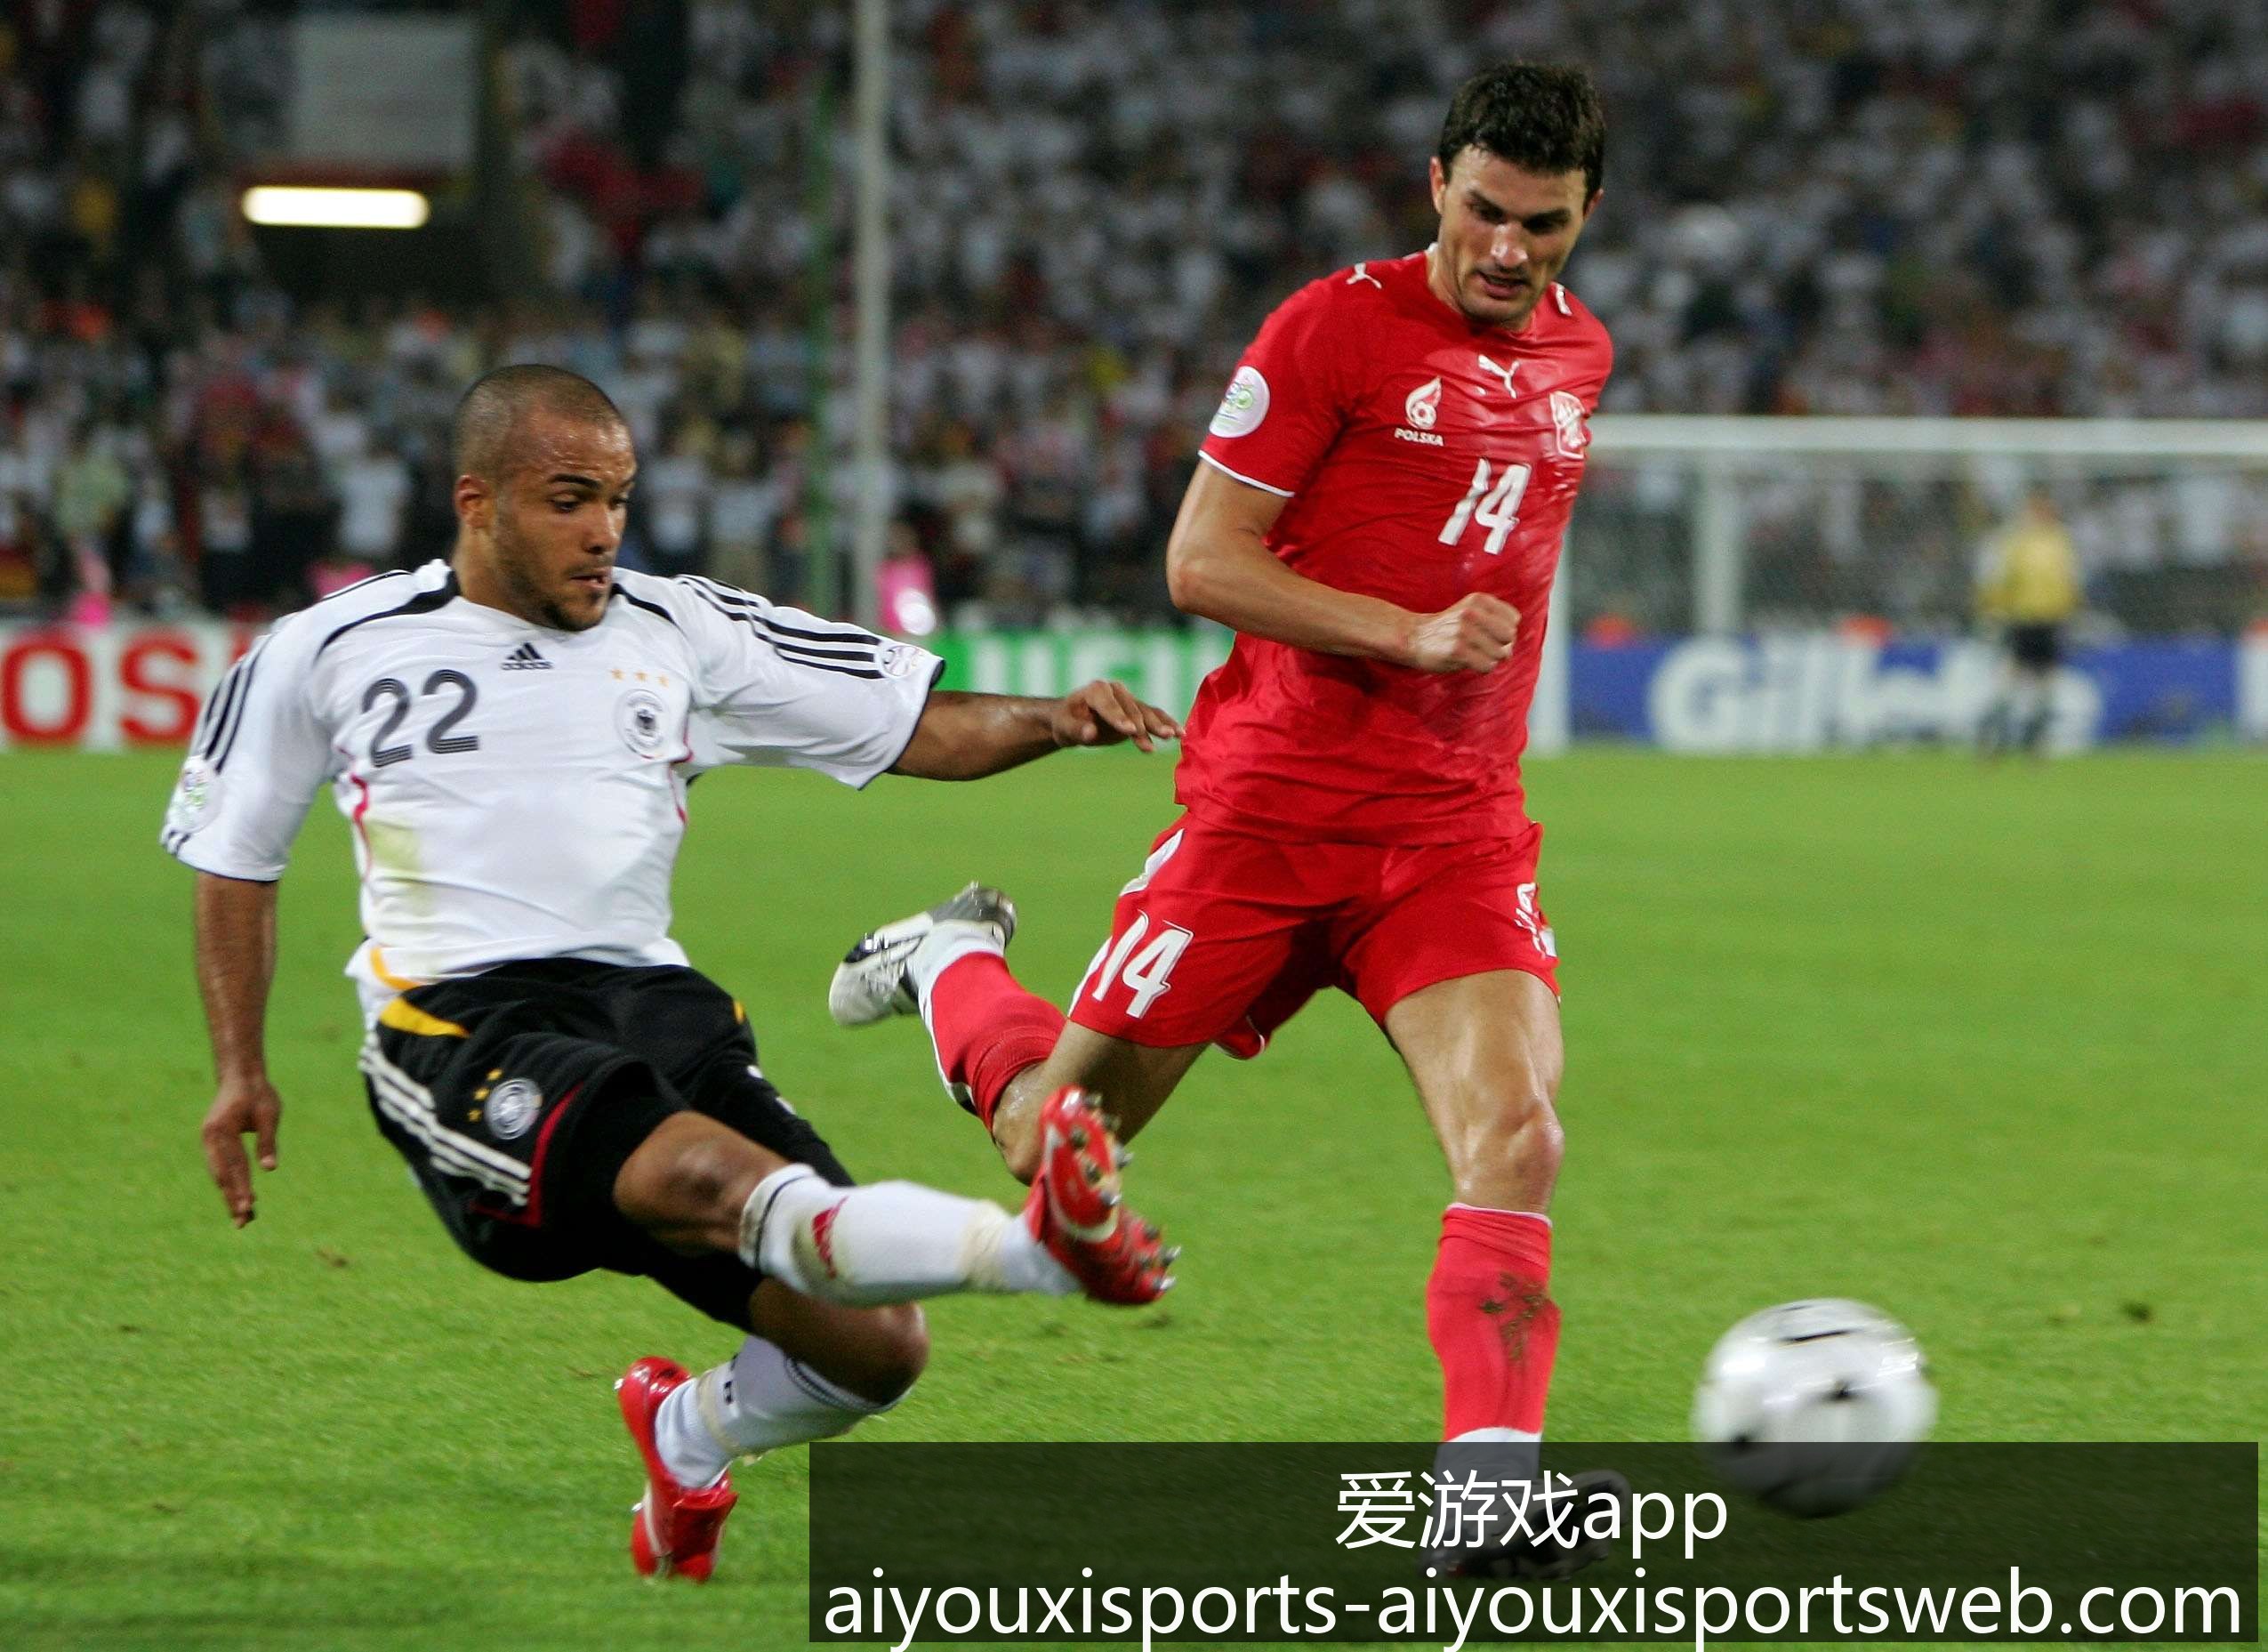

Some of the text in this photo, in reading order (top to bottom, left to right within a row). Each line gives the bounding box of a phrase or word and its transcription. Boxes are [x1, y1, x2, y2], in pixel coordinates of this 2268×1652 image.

[1394, 427, 1444, 447] POLSKA
[1438, 458, 1532, 555] 14
[361, 669, 480, 768] 22
[1091, 909, 1194, 1019] 14
